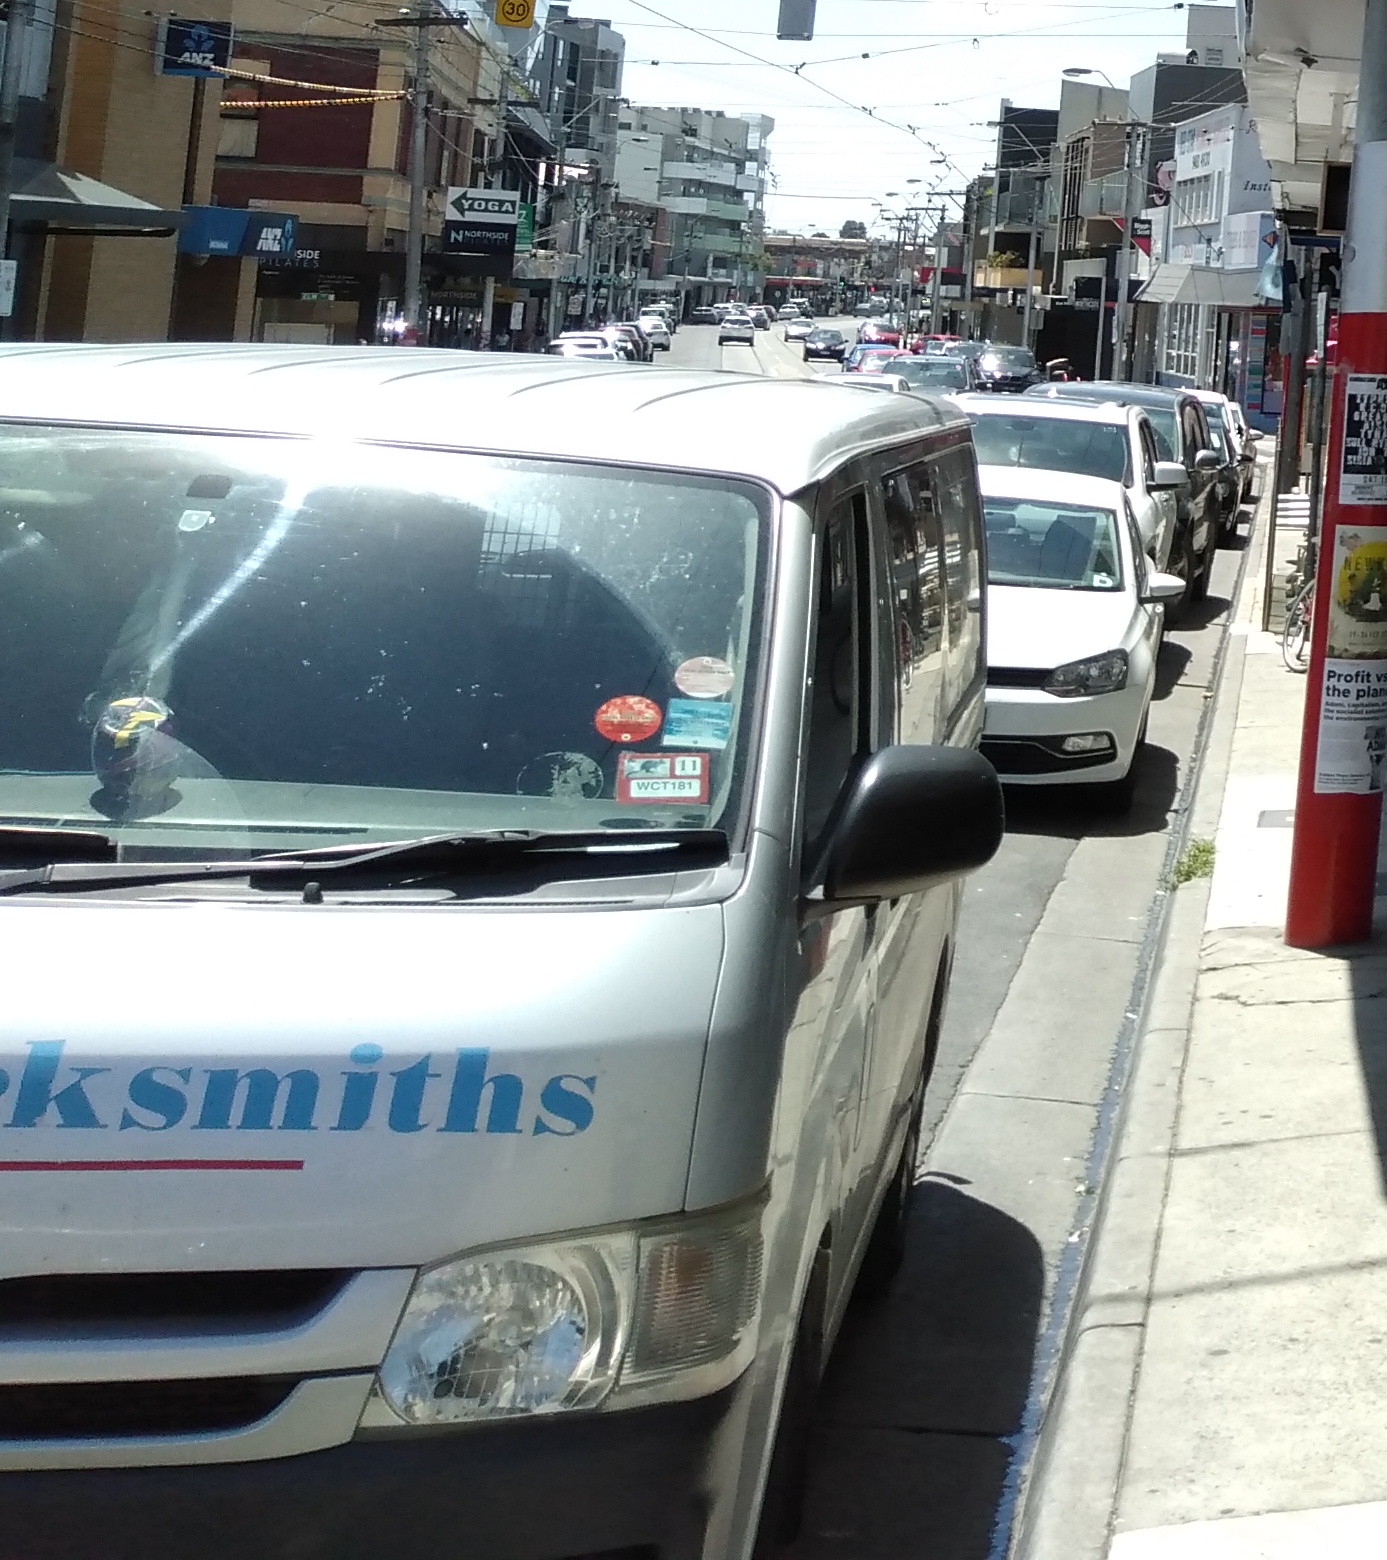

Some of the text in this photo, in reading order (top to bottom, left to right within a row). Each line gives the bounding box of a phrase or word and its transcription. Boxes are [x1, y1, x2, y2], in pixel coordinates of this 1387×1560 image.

[506, 2, 526, 17] 30
[177, 51, 215, 65] ANZ
[461, 199, 514, 213] YOGA
[464, 230, 509, 240] NORTHSIDE
[259, 259, 319, 269] PILATES
[1327, 669, 1372, 684] Profit
[1325, 685, 1351, 698] the
[680, 760, 697, 771] 11
[636, 781, 693, 791] WCT181
